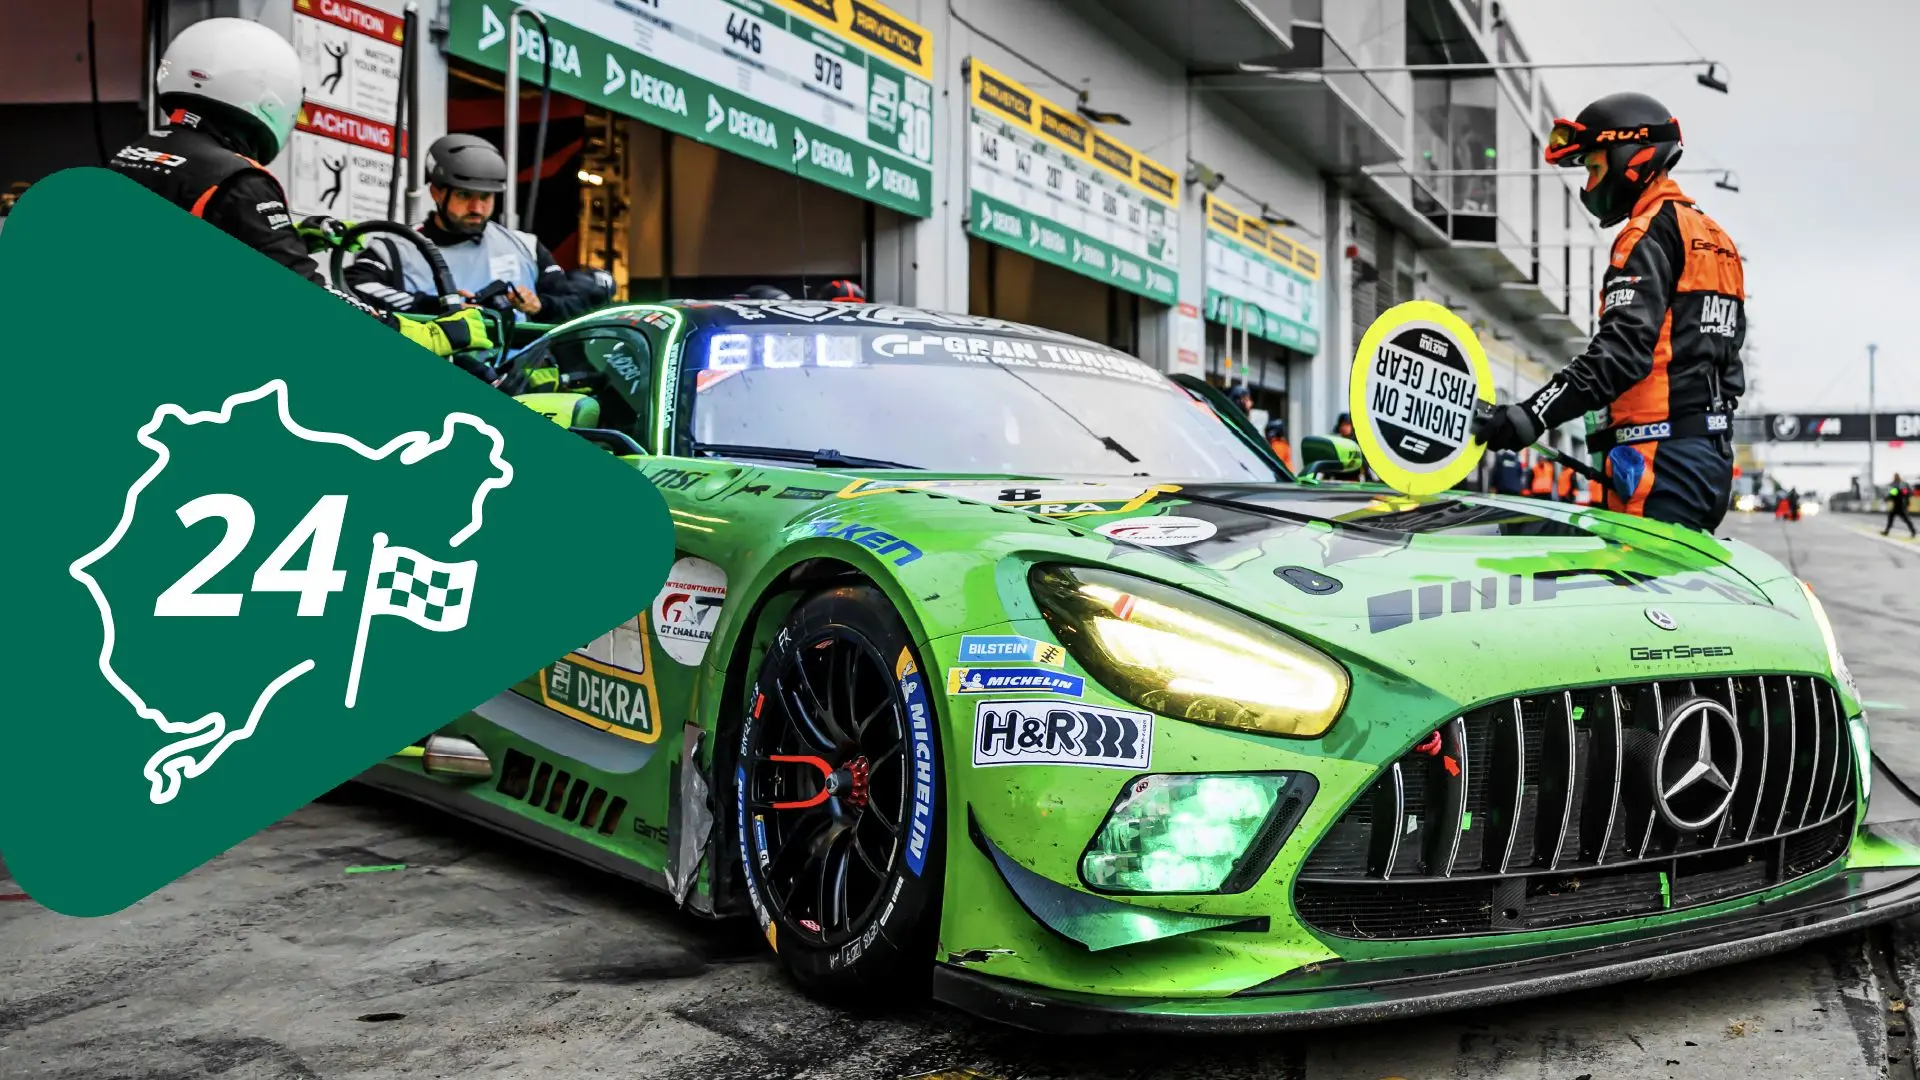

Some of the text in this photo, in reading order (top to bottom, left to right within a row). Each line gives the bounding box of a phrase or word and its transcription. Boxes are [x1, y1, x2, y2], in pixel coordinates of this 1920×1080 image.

[320, 0, 384, 33] CAUTION
[726, 12, 762, 54] 446
[856, 11, 917, 57] RAVENOL
[814, 53, 843, 90] 978
[630, 67, 688, 117] DEKRA
[312, 110, 390, 147] ACHTUNG
[728, 107, 778, 149] DEKRA
[898, 100, 931, 162] 30
[811, 139, 854, 177] DEKRA
[882, 166, 920, 201] DEKRA
[944, 336, 1038, 360] GRAN
[1042, 345, 1165, 383] TURISMO
[952, 353, 988, 364] THE
[1376, 346, 1477, 411] FIRST GEAR
[1373, 382, 1467, 443] ENGINE ON
[1531, 382, 1560, 415] HRX
[1616, 422, 1670, 441] sparco
[997, 487, 1042, 502] 8
[660, 624, 671, 634] GT
[968, 643, 1028, 655] BILSTEIN
[577, 670, 649, 730] DEKRA
[986, 676, 1073, 689] MICHELIN
[982, 709, 1085, 757] H&R
[909, 703, 932, 860] MICHELIN
